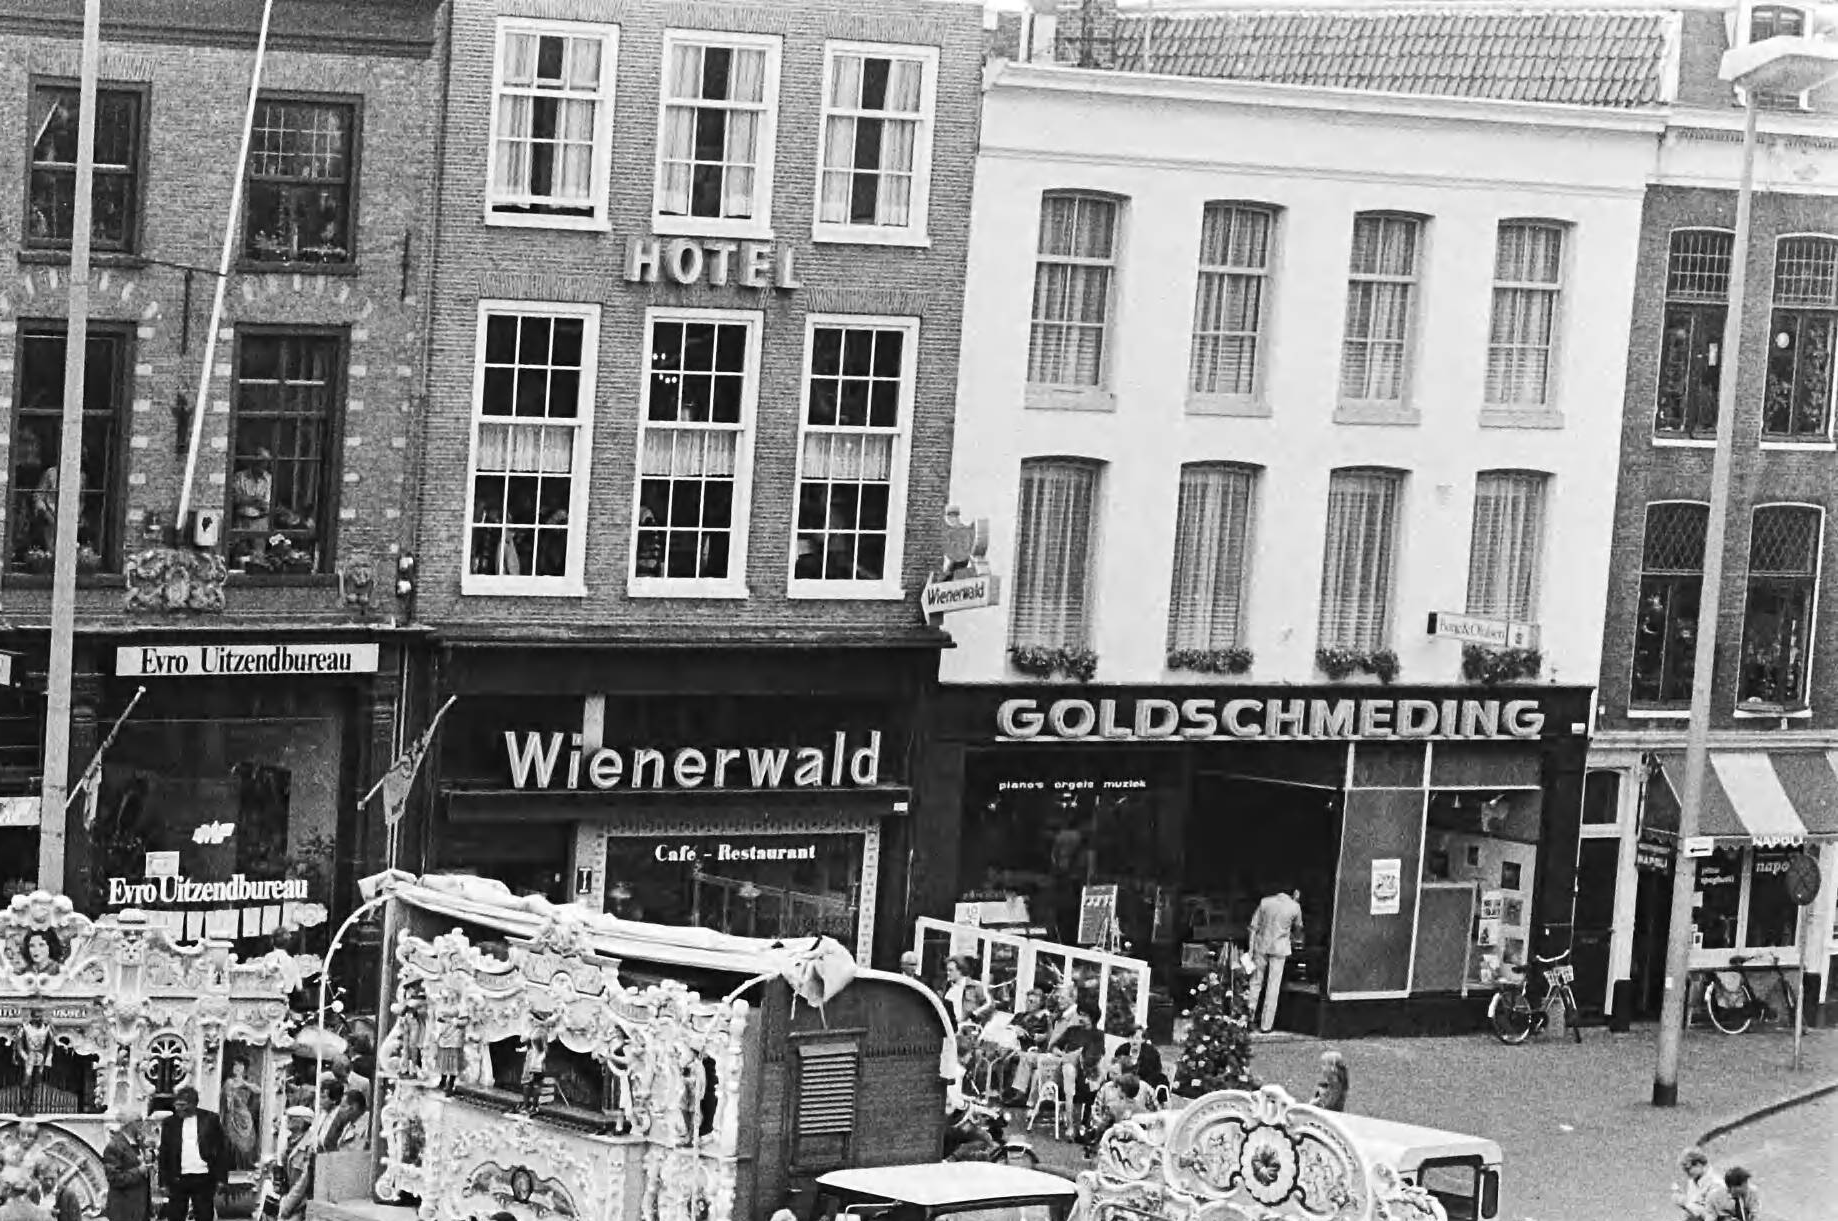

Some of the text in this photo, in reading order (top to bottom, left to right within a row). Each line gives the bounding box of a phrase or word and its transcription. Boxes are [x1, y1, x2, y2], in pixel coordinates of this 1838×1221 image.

[624, 237, 802, 289] HOTEL
[927, 580, 984, 605] Wienerwald
[141, 647, 351, 674] Evro Uitzendbureau
[997, 699, 1545, 738] GOLDSCHMEDING
[504, 731, 881, 788] Wienerwald
[1054, 780, 1094, 791] orgels
[1103, 780, 1147, 788] muziek
[654, 844, 698, 862] Café
[717, 844, 816, 861] Restaurant
[108, 873, 308, 905] Evro Uitzendbureau
